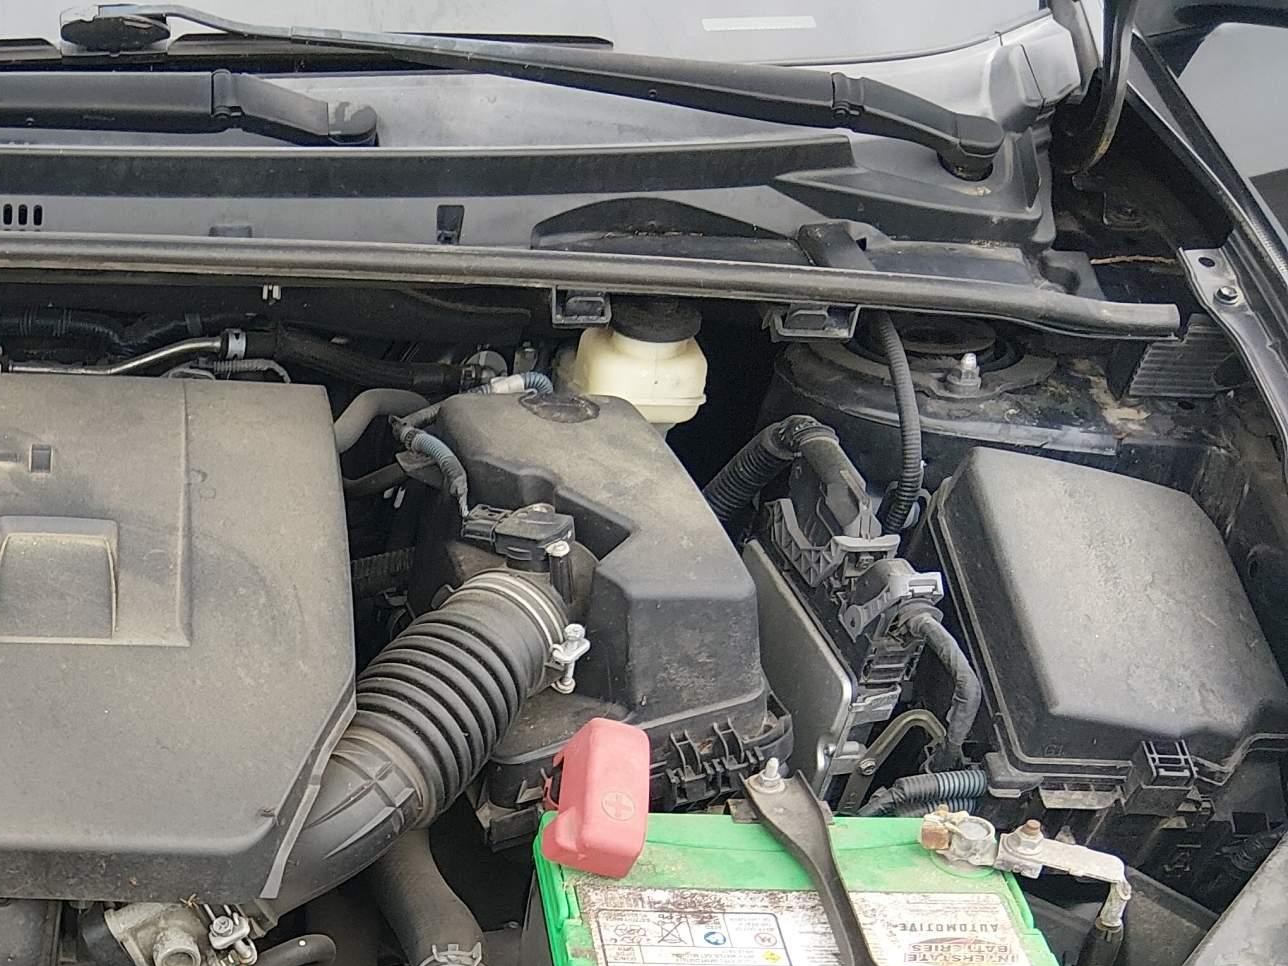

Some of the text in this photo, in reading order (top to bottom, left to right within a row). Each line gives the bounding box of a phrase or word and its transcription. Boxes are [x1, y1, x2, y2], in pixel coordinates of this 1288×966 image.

[898, 923, 999, 932] AUTOMOTIVE
[910, 944, 1009, 954] BATTERIES
[906, 954, 1017, 963] INTERSTATE
